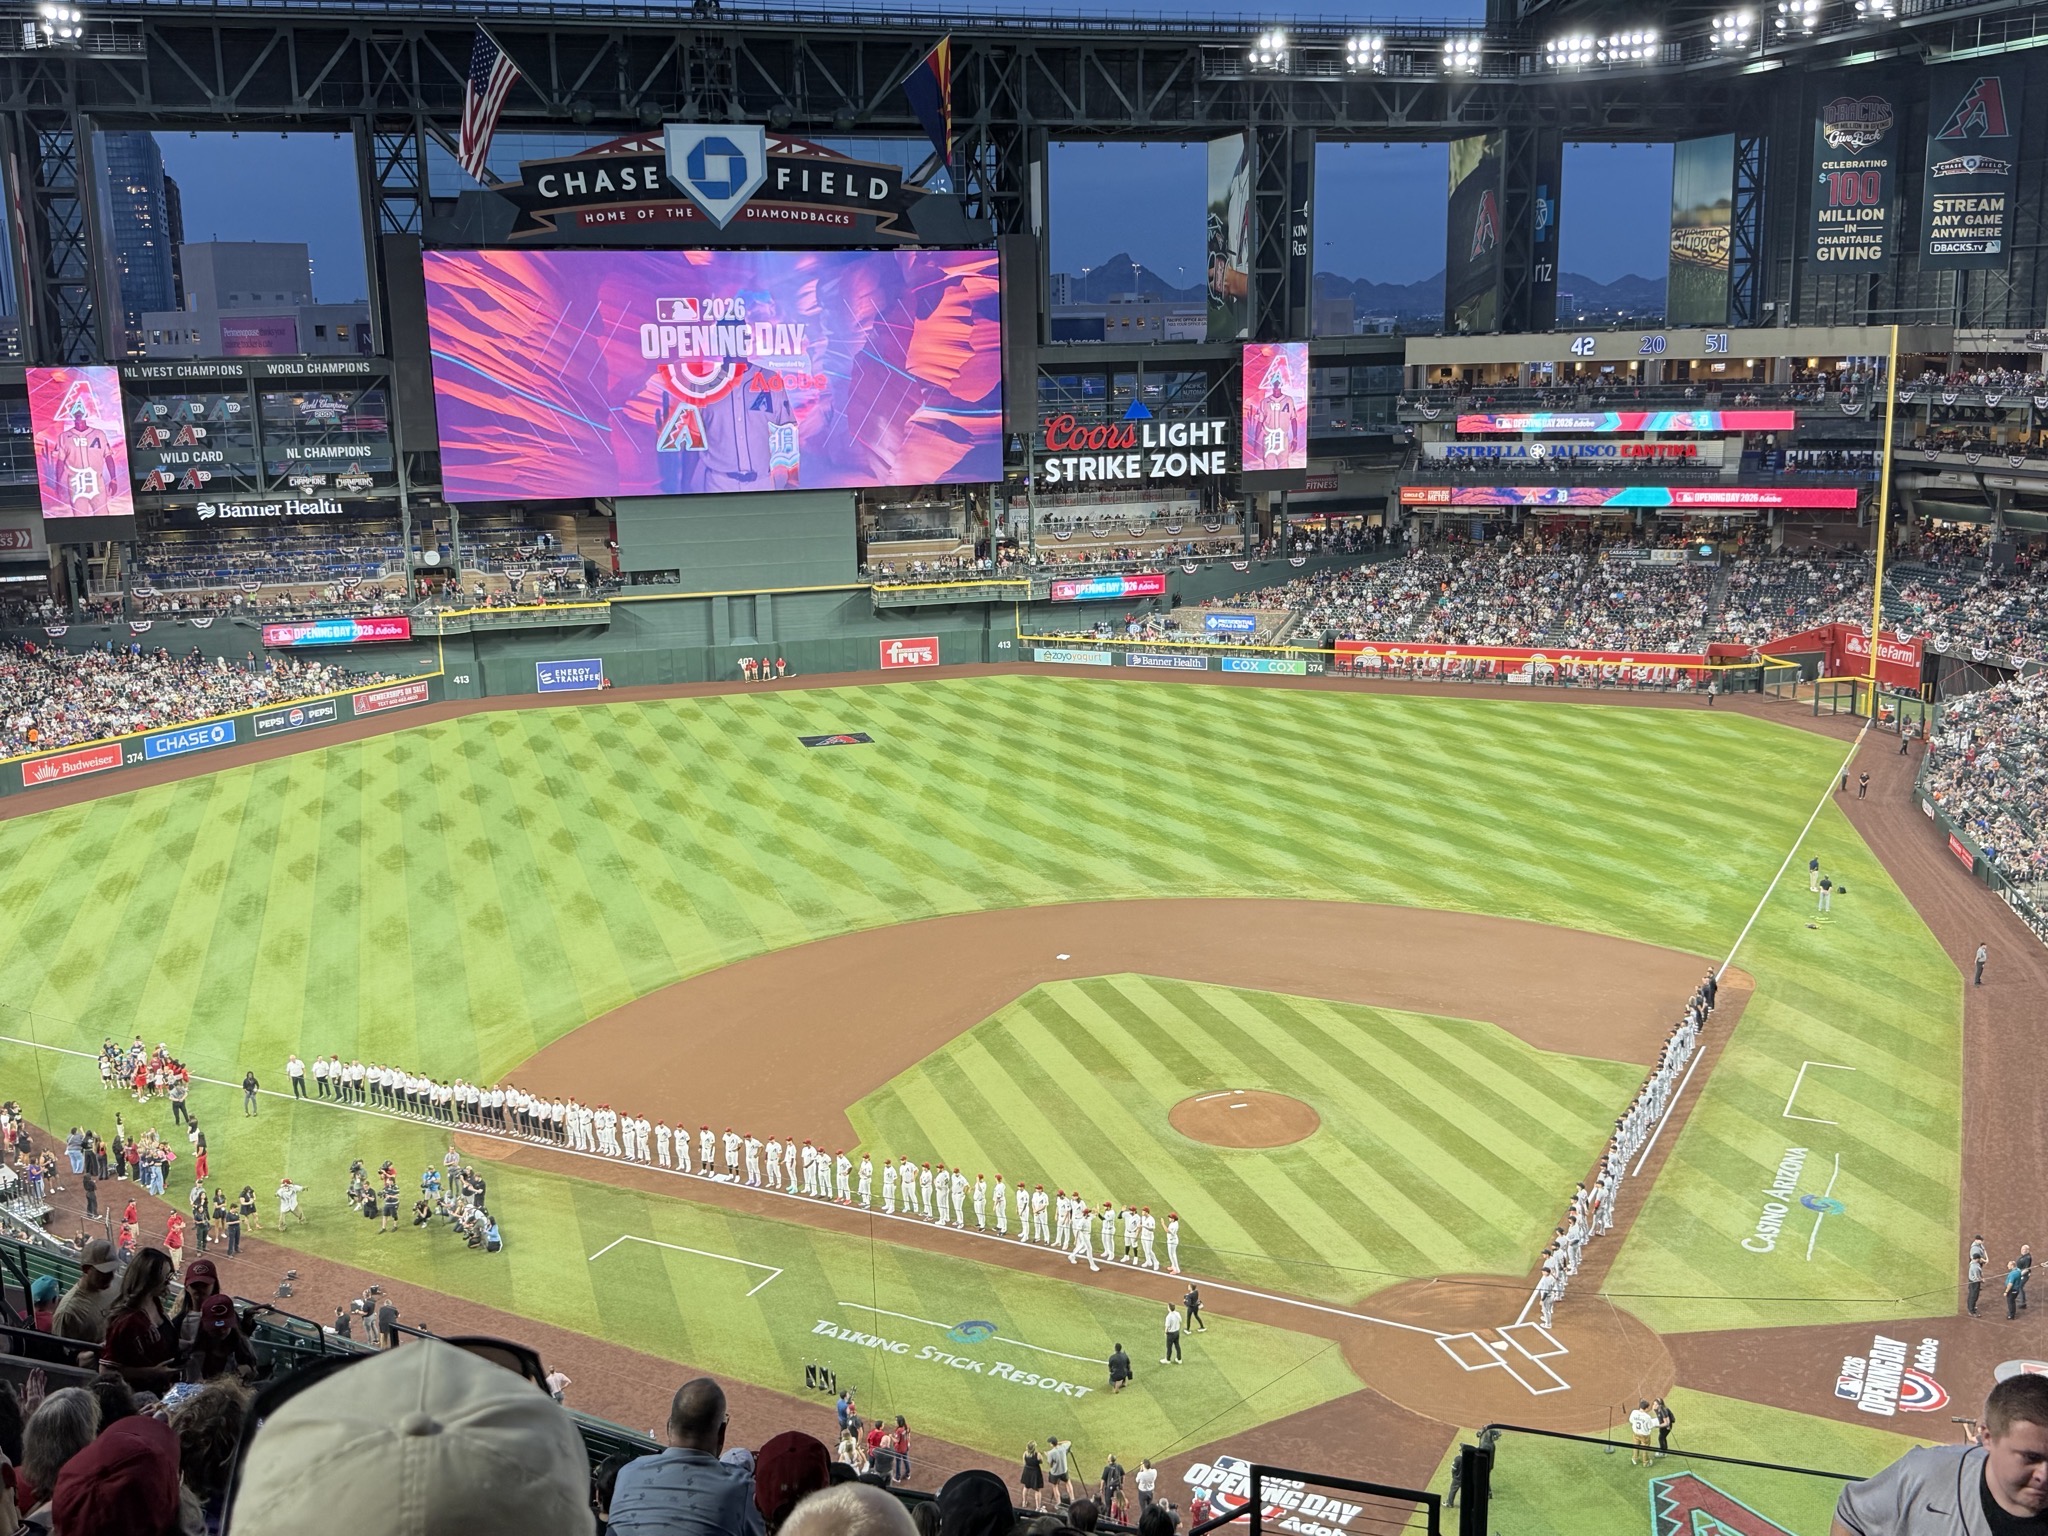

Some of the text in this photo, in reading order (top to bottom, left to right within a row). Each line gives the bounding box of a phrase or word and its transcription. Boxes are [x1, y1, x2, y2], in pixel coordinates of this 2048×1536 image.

[1829, 128, 1881, 146] Give Back
[1822, 159, 1888, 169] CELEBRATING
[538, 166, 889, 200] CHASE FIELD
[1933, 198, 2005, 213] STREAM
[585, 207, 850, 225] HOME OF THE DIAMONDBACKS
[1818, 208, 1885, 222] MILLION
[1932, 214, 2003, 226] ANY GAME
[1844, 224, 1857, 233] IN
[1931, 228, 2002, 238] ANYWHERE
[1673, 230, 1726, 259] Slugger
[1817, 235, 1883, 245] CHARITABLE
[1816, 246, 1882, 261] GIVING
[1934, 242, 1984, 252] DBACKS.TV
[703, 297, 745, 321] 2026
[224, 327, 260, 338] Perimenopause
[640, 321, 806, 359] OPENING DAY
[1571, 334, 1728, 356] 42 20 51
[267, 362, 370, 375] WORLD CHAMPIONS
[768, 360, 805, 368] Presented by
[124, 364, 243, 378] NL WEST CHAMPIONS
[750, 370, 828, 392] Adobe
[155, 405, 166, 414] 99
[192, 404, 201, 412] 01
[228, 403, 238, 411] 02
[300, 398, 349, 411] World Champions
[1513, 418, 1543, 428] OPENING
[1556, 417, 1573, 427] 2026
[1573, 419, 1595, 427] Adobe
[158, 430, 167, 438] 07
[195, 429, 204, 437] 11
[1044, 414, 1227, 451] Coors LIGHT
[160, 451, 223, 463] WILD CARD
[286, 446, 371, 459] NL CHAMPIONS
[1446, 444, 1527, 458] ESTRELLA
[1548, 444, 1617, 458] JALISCO
[1045, 451, 1226, 483] STRIKE ZONE
[163, 474, 171, 482] 17
[200, 472, 209, 480] 23
[289, 476, 326, 487] CHAMPIONS
[1306, 480, 1337, 490] FITNESS
[1694, 493, 1782, 503] OPENING DAY 2026 Adobe
[219, 498, 343, 518] Banner Health
[1076, 583, 1106, 594] OPENING
[1106, 582, 1120, 593] DAY
[1120, 581, 1138, 591] 2026
[294, 624, 402, 640] OPENING DAY 2026 Adobe
[998, 641, 1011, 649] 413
[886, 641, 932, 664] fry's
[1862, 641, 1913, 663] Stte Farm
[738, 657, 753, 665] 407
[1142, 655, 1201, 667] Banner Health
[1232, 660, 1295, 672] COX COX
[555, 667, 590, 676] ENERGY
[1308, 663, 1323, 673] 374
[453, 675, 470, 684] 413
[555, 674, 600, 683] TRANSFER
[369, 685, 425, 702] MEMBERSHIPS ON SALE
[259, 717, 285, 729] PEPSI
[309, 706, 333, 719] PEPSI
[156, 731, 209, 752] CHASE
[62, 755, 114, 774] Budweiser
[127, 752, 144, 764] 374
[1913, 1337, 1939, 1374] Adobe
[1842, 1355, 1867, 1379] 2026
[1857, 1334, 1908, 1416] OPENING DAY
[1299, 1492, 1363, 1525] DAY
